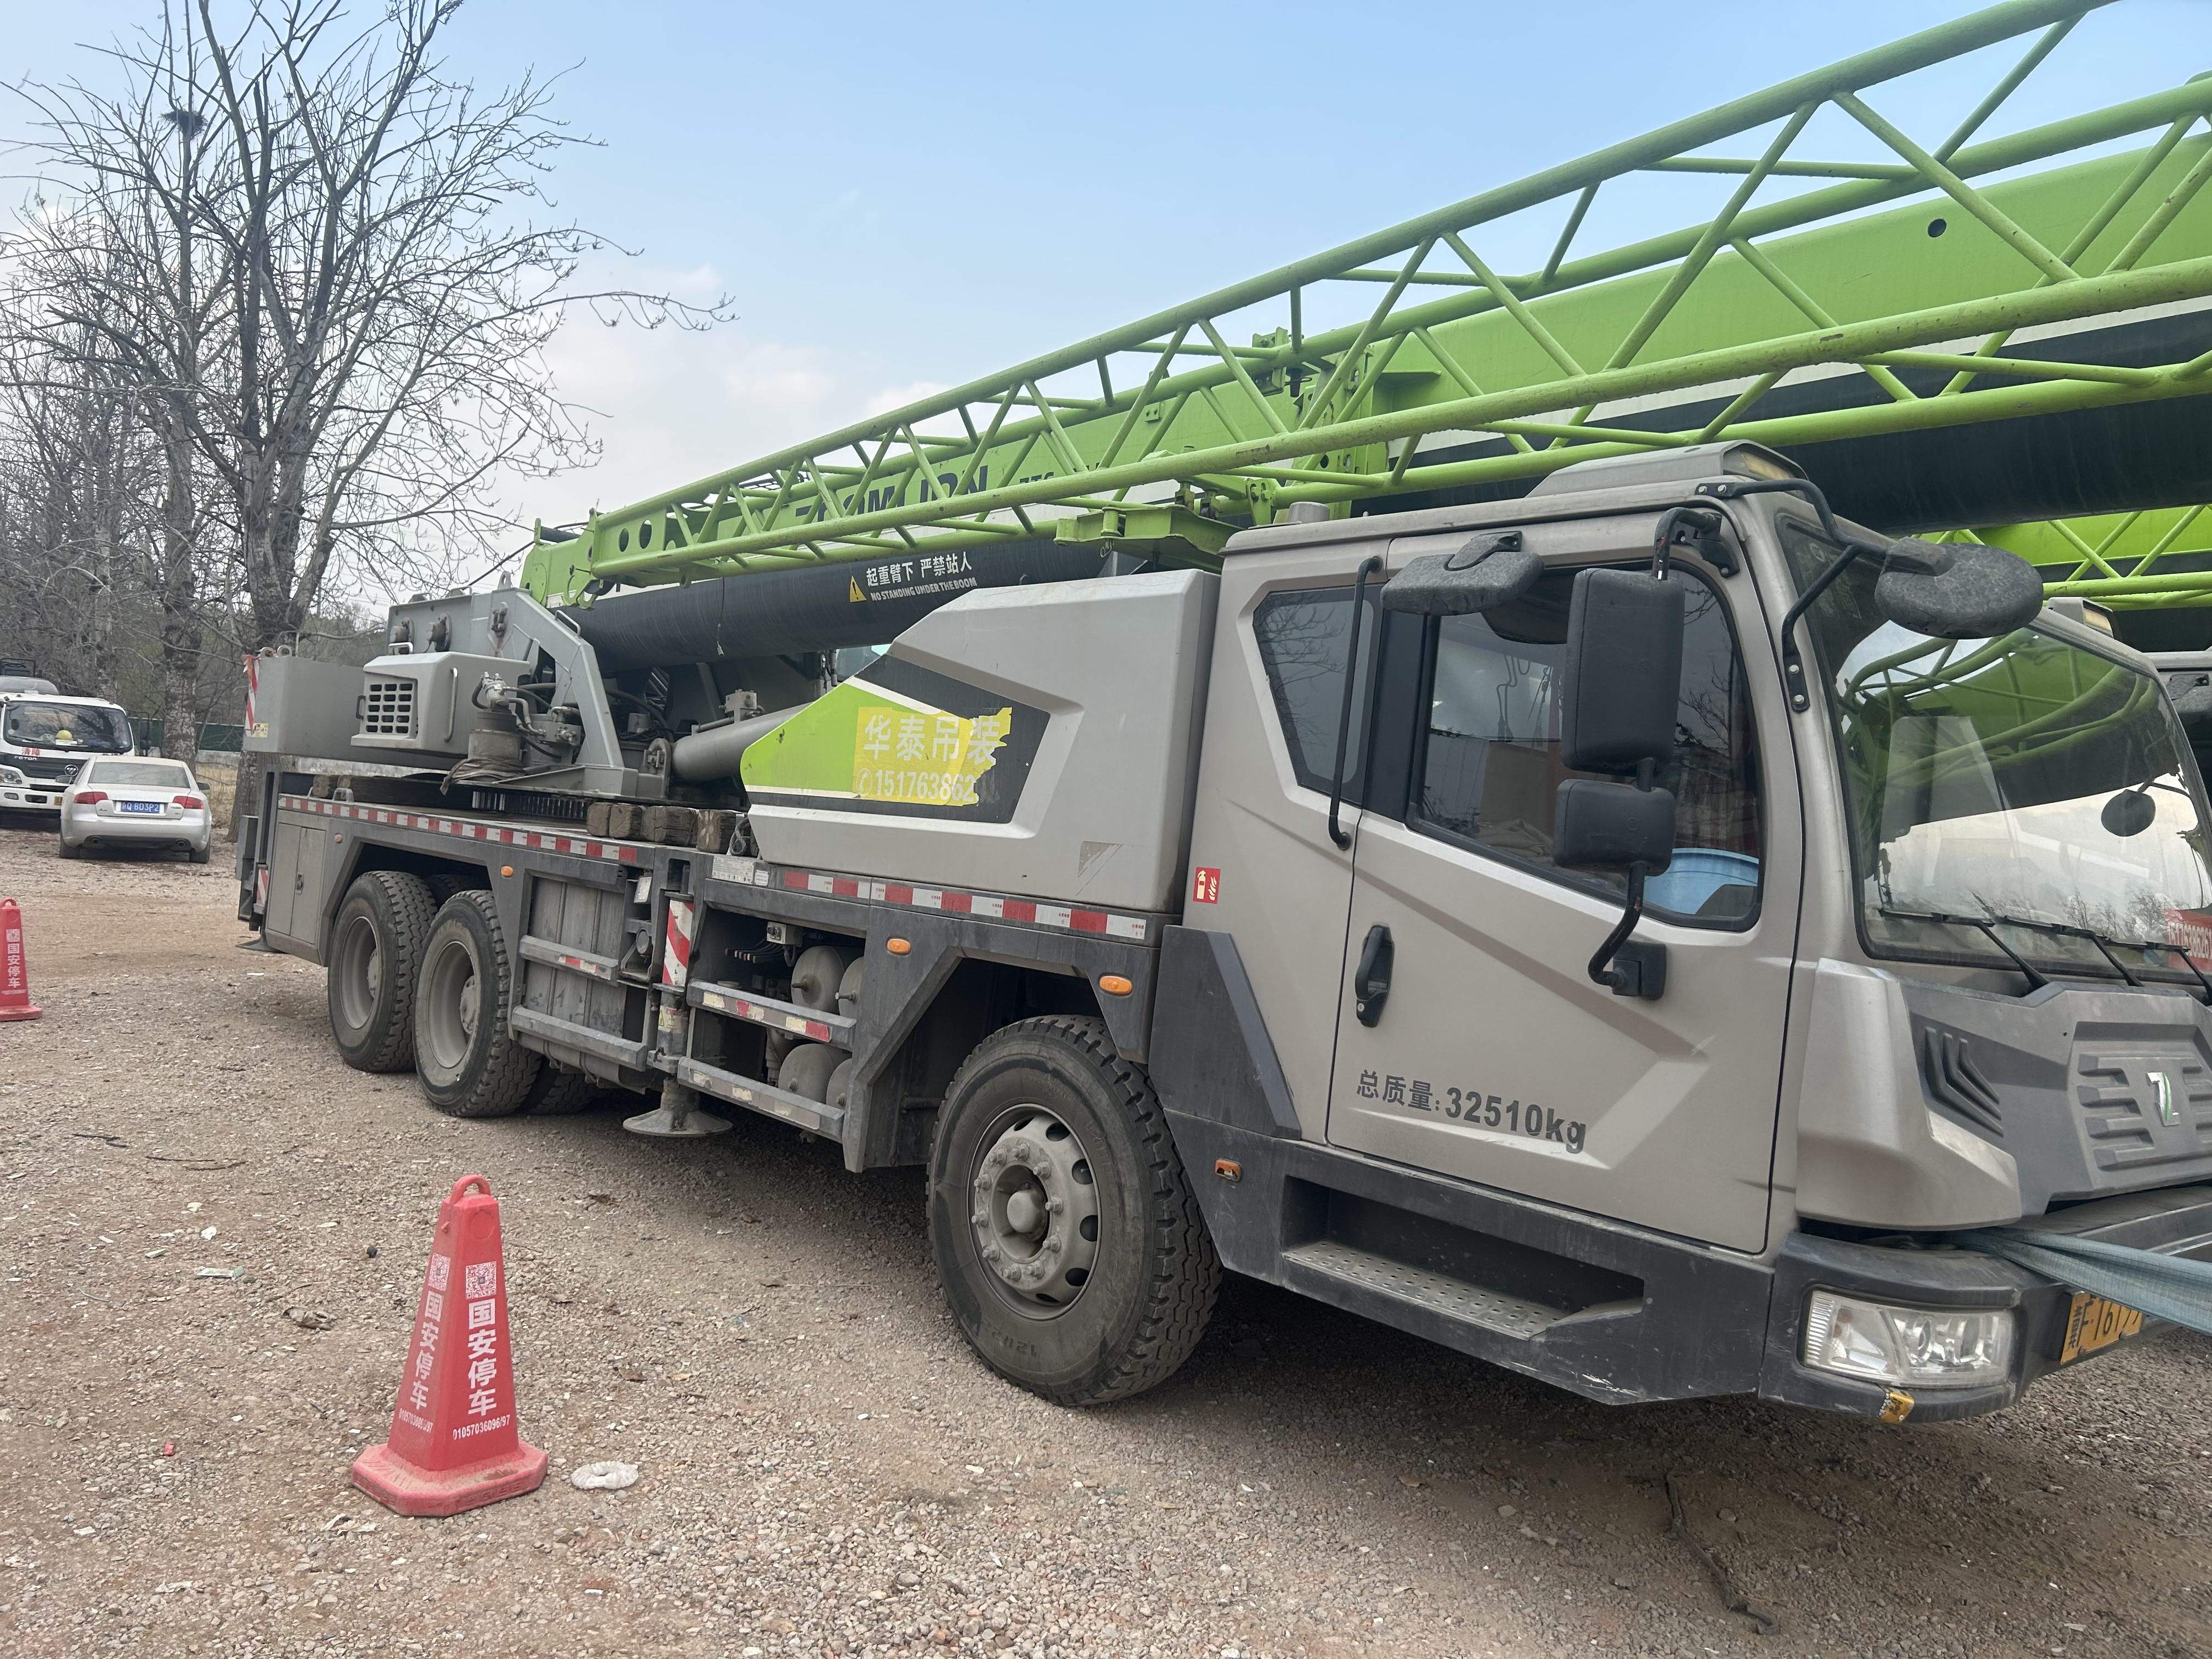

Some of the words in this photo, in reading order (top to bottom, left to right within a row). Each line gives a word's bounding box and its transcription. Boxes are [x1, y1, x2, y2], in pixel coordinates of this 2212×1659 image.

[866, 561, 913, 587] 起重臂下
[920, 551, 973, 579] 严禁站人
[870, 591, 882, 601] NO
[882, 586, 916, 600] STANDING
[916, 583, 940, 595] UNDER
[940, 580, 955, 591] THE
[953, 577, 978, 590] BOOM
[862, 714, 1001, 765] 华泰吊装
[7, 943, 21, 988] 国安停车
[410, 1290, 444, 1410] 国安停车
[468, 1298, 497, 1417] 国安停车
[453, 1414, 511, 1440] 01057036096/97
